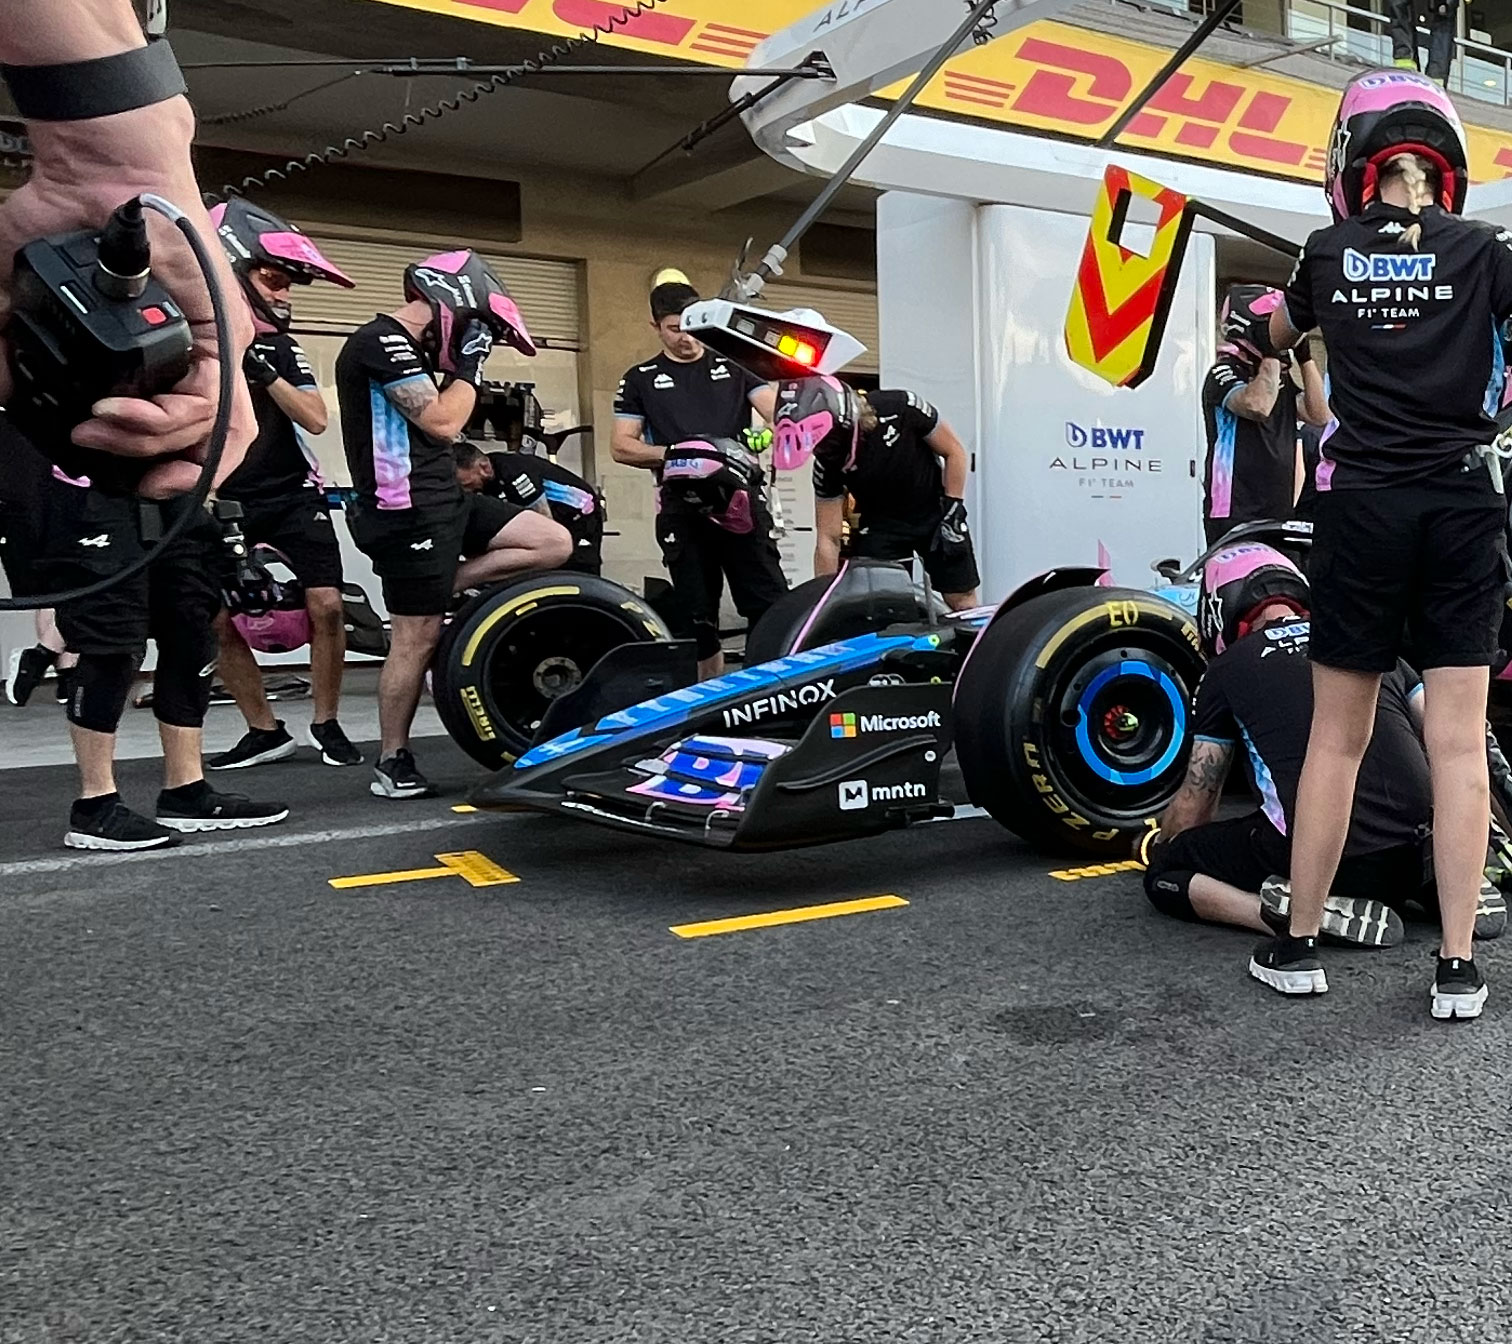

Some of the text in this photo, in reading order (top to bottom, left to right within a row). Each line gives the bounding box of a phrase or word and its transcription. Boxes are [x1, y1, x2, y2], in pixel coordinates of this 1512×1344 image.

[1011, 37, 1309, 166] DHL
[1370, 254, 1436, 281] BWT
[1332, 285, 1454, 304] ALPINE
[1381, 307, 1420, 318] TEAM
[1091, 427, 1144, 450] BWT
[1049, 457, 1162, 472] ALPINE
[1101, 478, 1134, 488] TEAM
[722, 679, 837, 728] INFINOX
[860, 711, 942, 733] Microsoft
[871, 781, 926, 801] mntn
